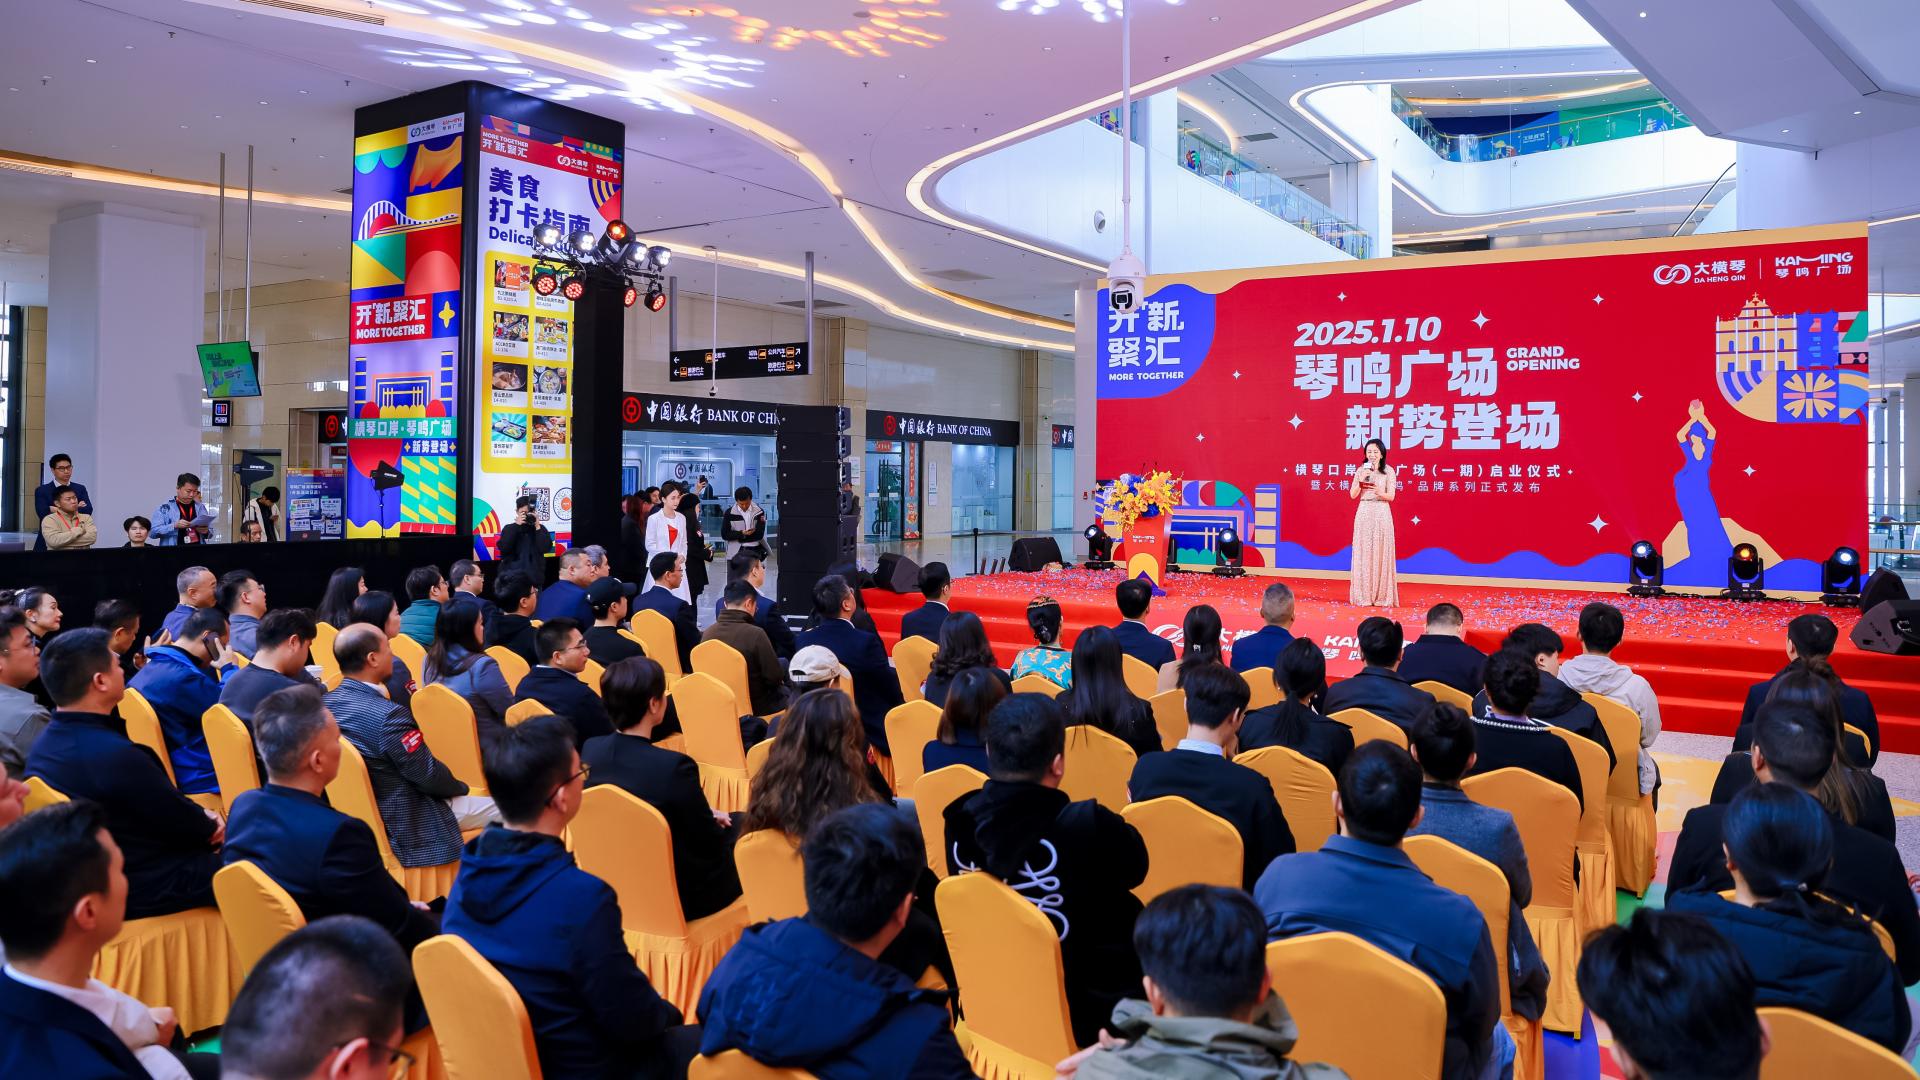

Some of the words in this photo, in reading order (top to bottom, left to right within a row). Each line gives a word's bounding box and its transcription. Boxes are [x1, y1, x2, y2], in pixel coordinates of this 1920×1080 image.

[483, 132, 500, 141] MORE
[500, 136, 529, 148] TOGETHER
[489, 167, 540, 202] 美食
[489, 197, 590, 236] 打卡指南
[1694, 259, 1746, 275] 大横琴
[1775, 264, 1852, 278] 琴鸣广场
[356, 299, 426, 326] 开新聚汇
[356, 328, 380, 340] MORE
[381, 324, 425, 337] TOGETHER
[1293, 316, 1442, 347] 2025.1.10
[1108, 336, 1180, 368] 聚汇
[1506, 346, 1565, 358] GRAND
[1293, 347, 1498, 400] 琴鸣广场
[1506, 358, 1580, 371] OPENING
[1109, 373, 1134, 381] MORE
[1137, 371, 1185, 380] TOGETHER
[646, 400, 703, 425] 中国银行
[707, 408, 739, 422] BANK
[741, 411, 755, 423] OF
[899, 417, 936, 437] 中国银行
[937, 423, 957, 434] BANK
[959, 425, 969, 435] OF
[970, 426, 992, 437] CHINA
[1345, 401, 1561, 450] 新势登场
[412, 440, 448, 454] 新势登场
